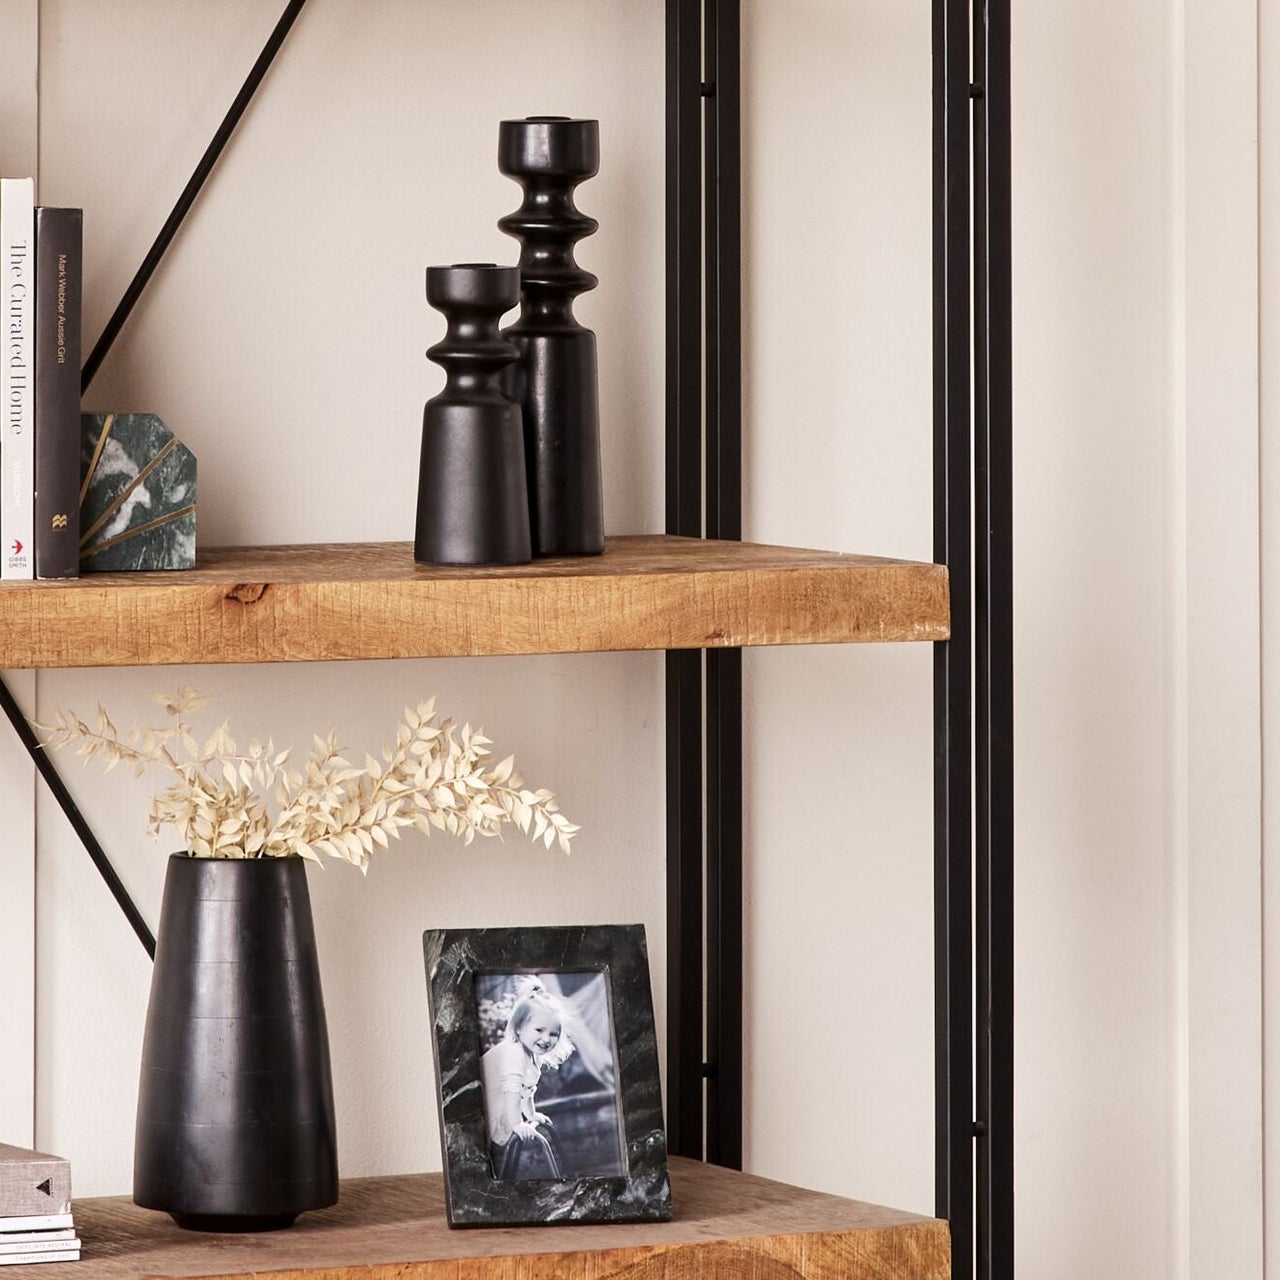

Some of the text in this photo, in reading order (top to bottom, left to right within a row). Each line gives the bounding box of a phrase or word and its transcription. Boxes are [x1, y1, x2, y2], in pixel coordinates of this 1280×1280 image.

[10, 240, 27, 435] The Curated Home
[57, 254, 67, 364] Mark Webber Aussie Grit
